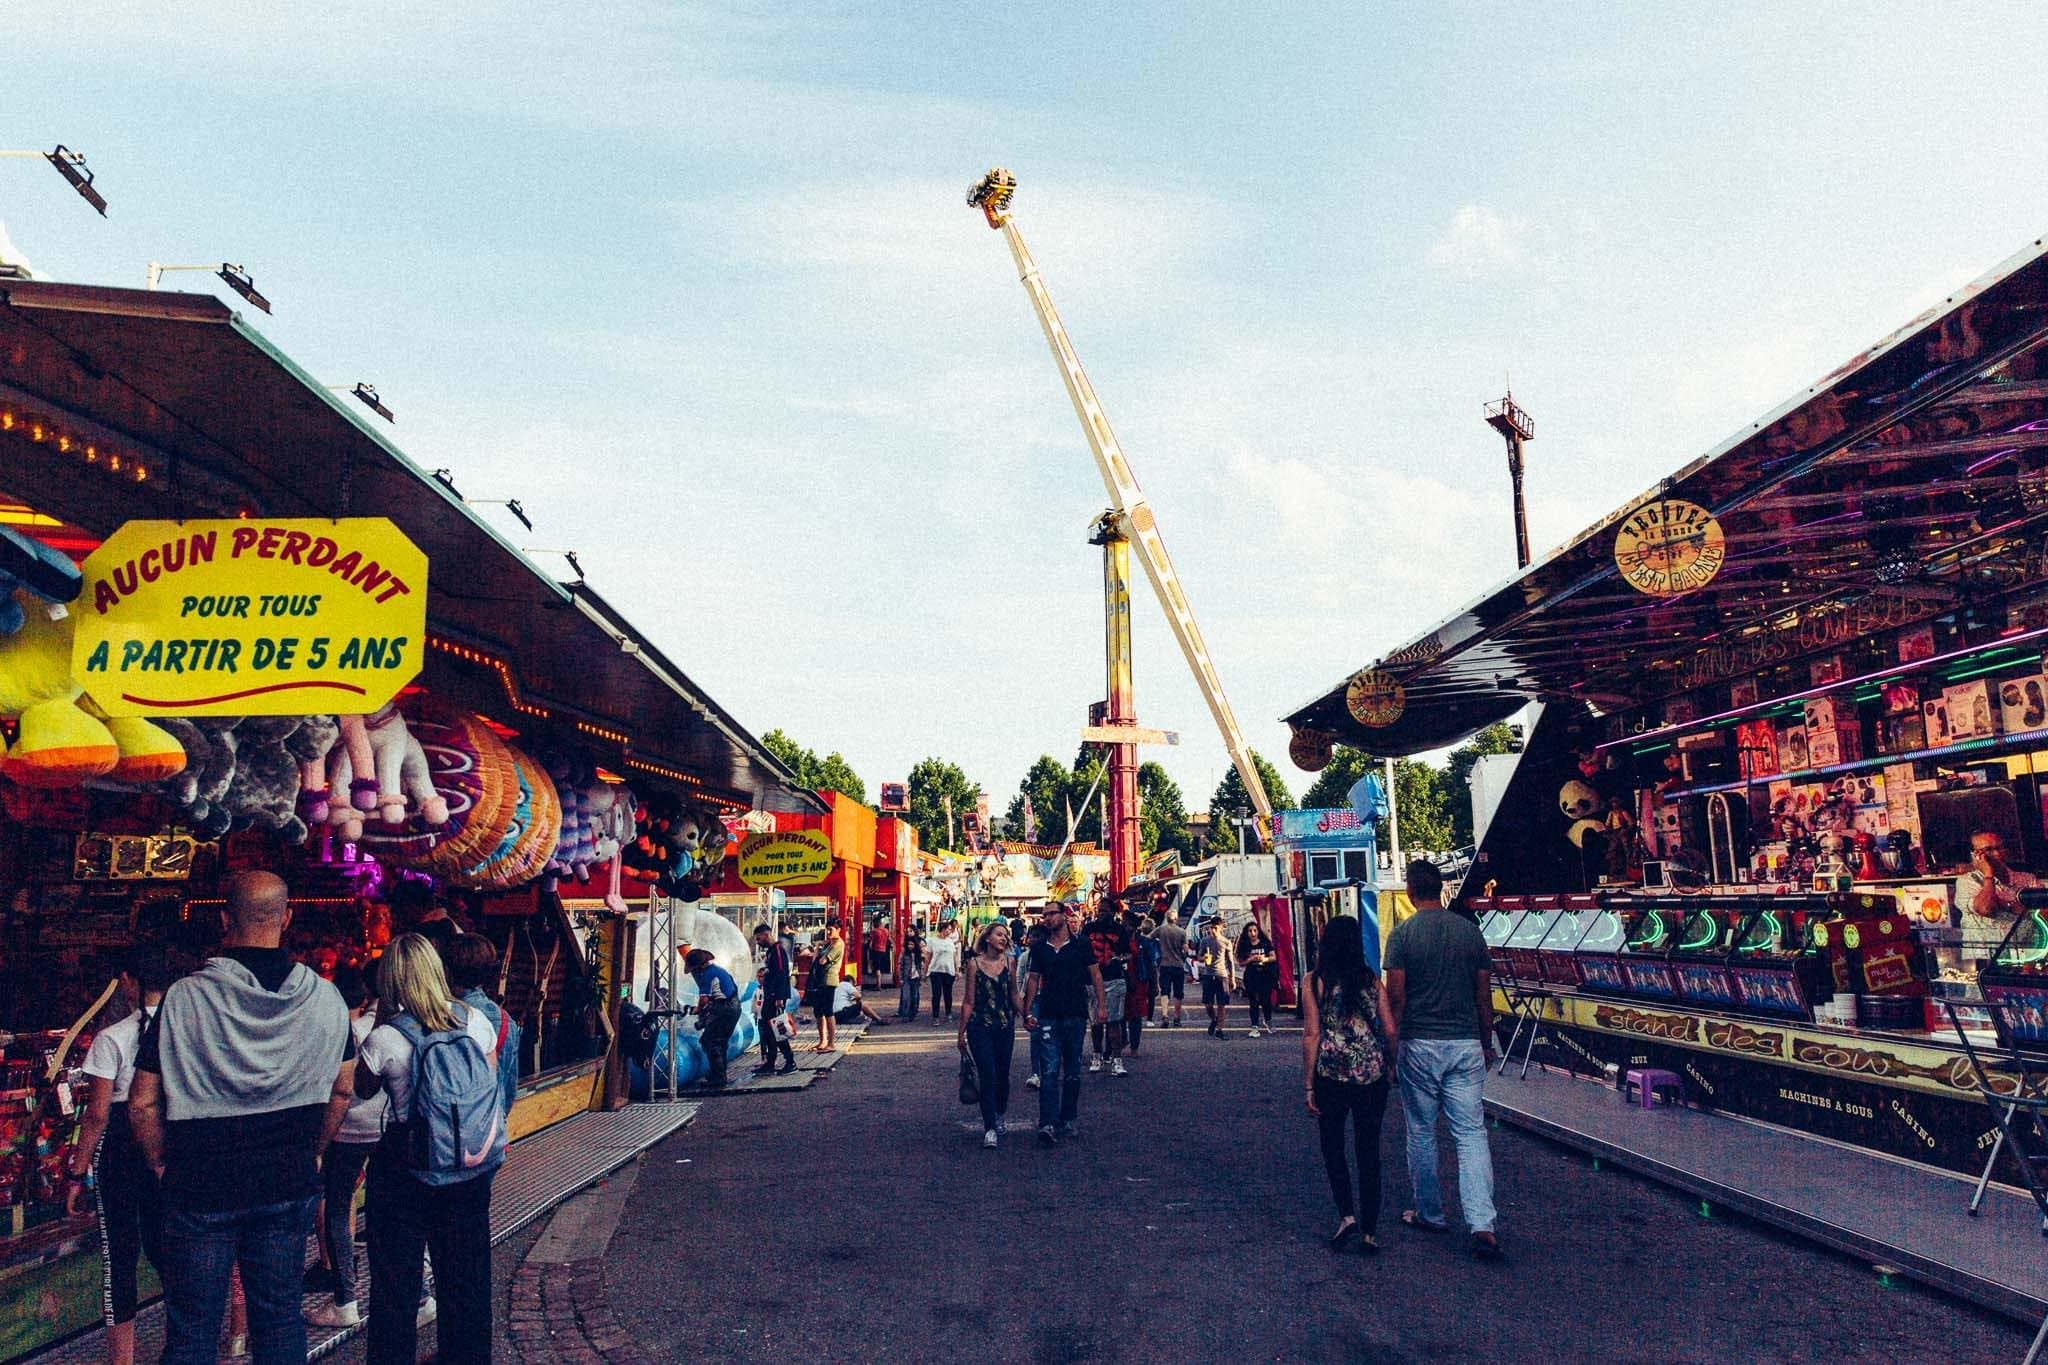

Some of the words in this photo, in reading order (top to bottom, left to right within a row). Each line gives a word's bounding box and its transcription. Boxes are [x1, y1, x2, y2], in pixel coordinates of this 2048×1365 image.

[1623, 505, 1712, 538] TROUVEZ
[94, 531, 218, 615] AUCUN
[231, 527, 411, 605] PERDANT
[181, 595, 250, 619] POUR
[259, 595, 321, 617] TOUS
[86, 640, 109, 672] A
[120, 640, 241, 674] PARTIR
[252, 638, 299, 670] DE
[307, 637, 330, 669] 5
[338, 637, 408, 670] ANS
[742, 835, 773, 860] AUCUN
[777, 833, 827, 852] PERDANT
[766, 852, 785, 860] POUR
[743, 867, 749, 877] A
[752, 864, 784, 876] PARTIR
[787, 863, 799, 873] DE
[801, 862, 807, 872] 5
[810, 861, 827, 872] ANS
[1610, 1013, 1692, 1042] stand
[1711, 1026, 1776, 1055] des
[1686, 1063, 1715, 1096] CASINO
[1779, 1088, 1831, 1110] MACHINES
[1835, 1101, 1844, 1112] A
[1846, 1103, 1874, 1120] SOUS
[1891, 1099, 1936, 1149] CASINO
